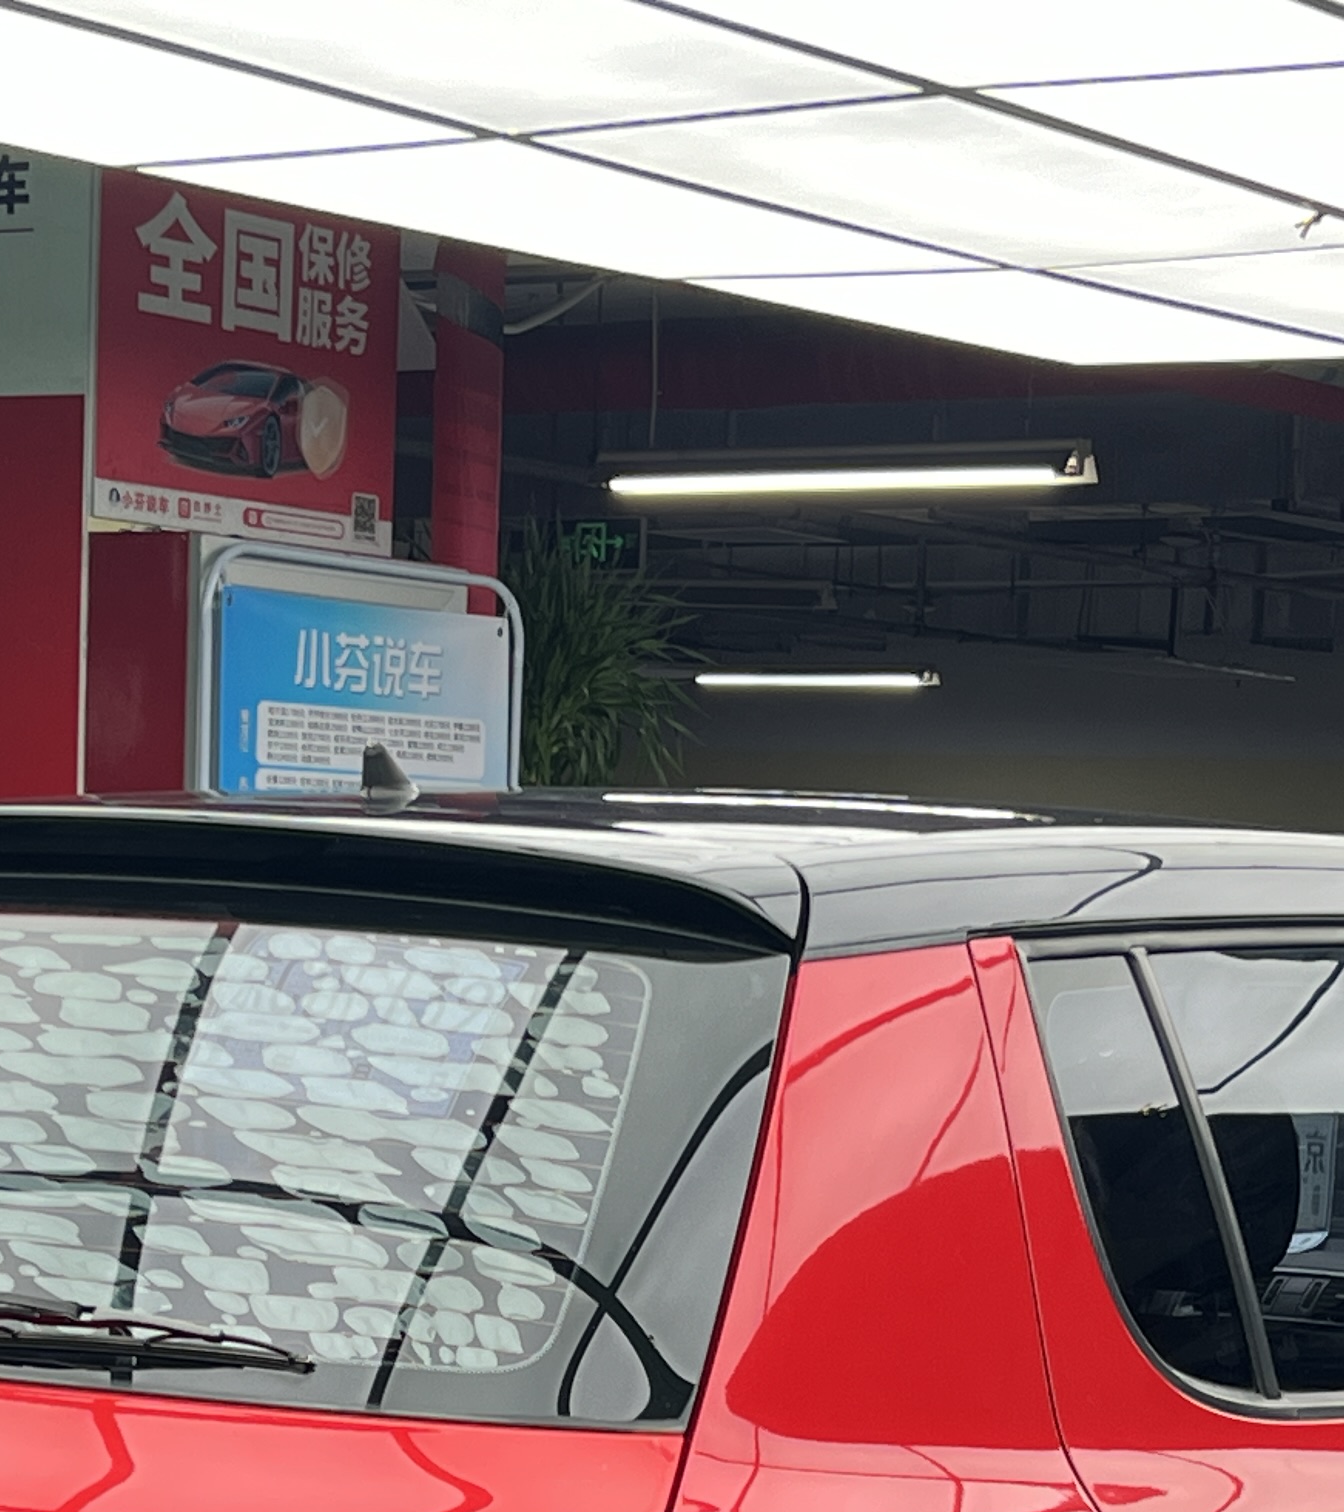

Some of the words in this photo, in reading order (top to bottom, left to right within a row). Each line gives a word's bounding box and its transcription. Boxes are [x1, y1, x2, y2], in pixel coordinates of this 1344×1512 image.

[135, 190, 297, 343] 全国
[299, 222, 372, 293] 保修
[295, 286, 370, 356] 服务
[293, 628, 444, 700] 小芬说车
